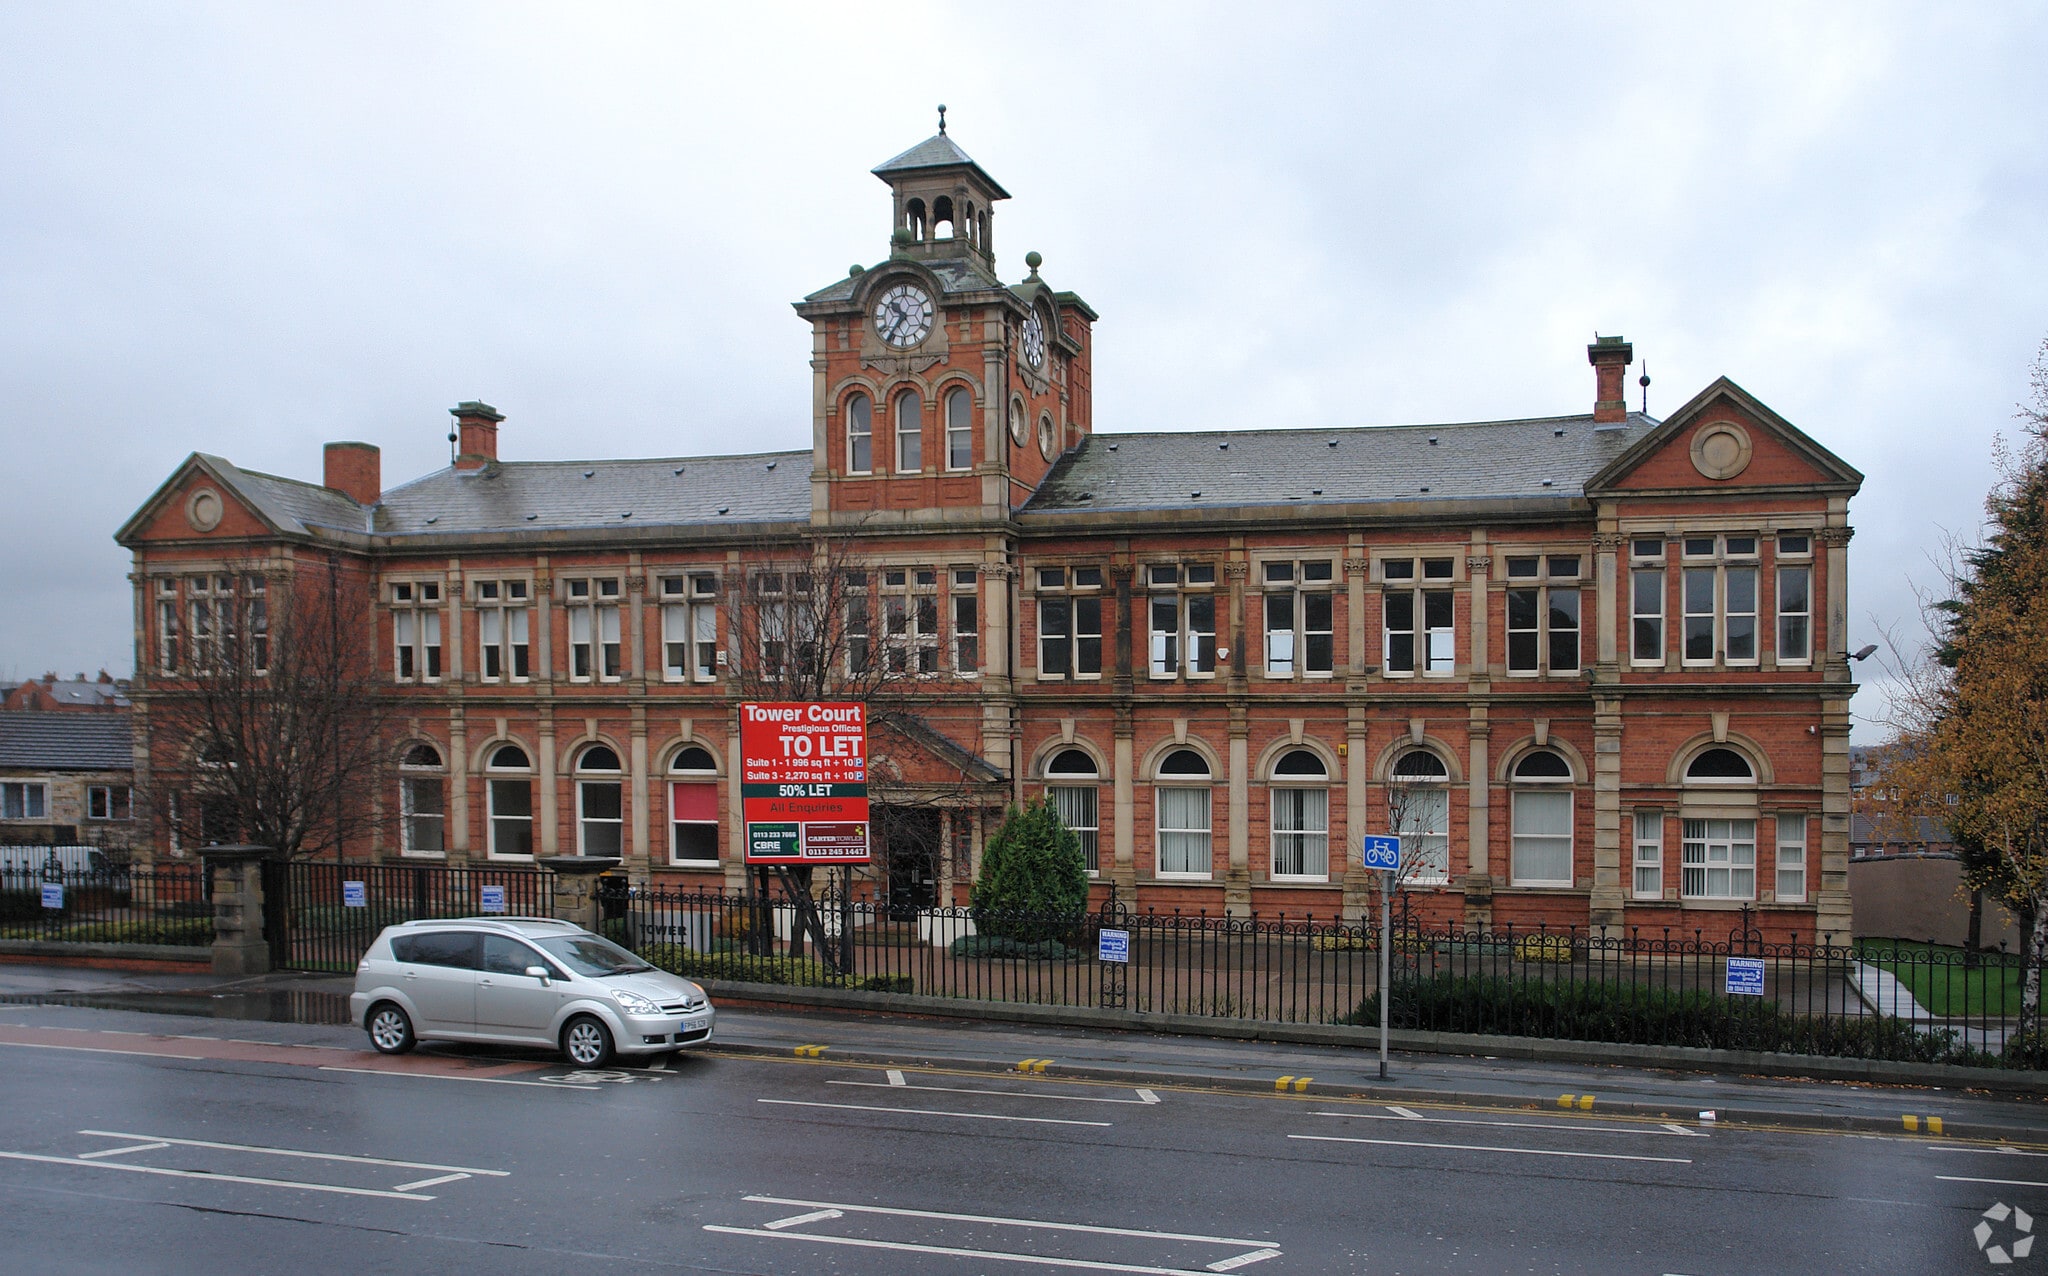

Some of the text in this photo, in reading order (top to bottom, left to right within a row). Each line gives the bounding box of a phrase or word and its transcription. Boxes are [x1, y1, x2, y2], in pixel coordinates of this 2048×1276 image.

[745, 704, 861, 722] Tower Court
[782, 724, 862, 734] Prestigious Offices
[779, 735, 863, 757] TO LET
[746, 758, 770, 767] Suite
[772, 758, 777, 767] 1
[811, 759, 823, 769] sq
[824, 758, 831, 767] ft
[746, 771, 770, 780] Suite
[772, 771, 778, 780] 3
[785, 771, 809, 781] 2,270
[811, 772, 823, 782] sq
[824, 771, 831, 780] ft
[779, 784, 833, 797] 50% LET
[770, 803, 843, 814] All Enquiries
[753, 841, 781, 849] CBRE
[808, 848, 864, 856] 0113 245 1447
[640, 924, 688, 936] TOWER
[1102, 931, 1127, 939] WARNING
[1729, 960, 1763, 969] WARNING
